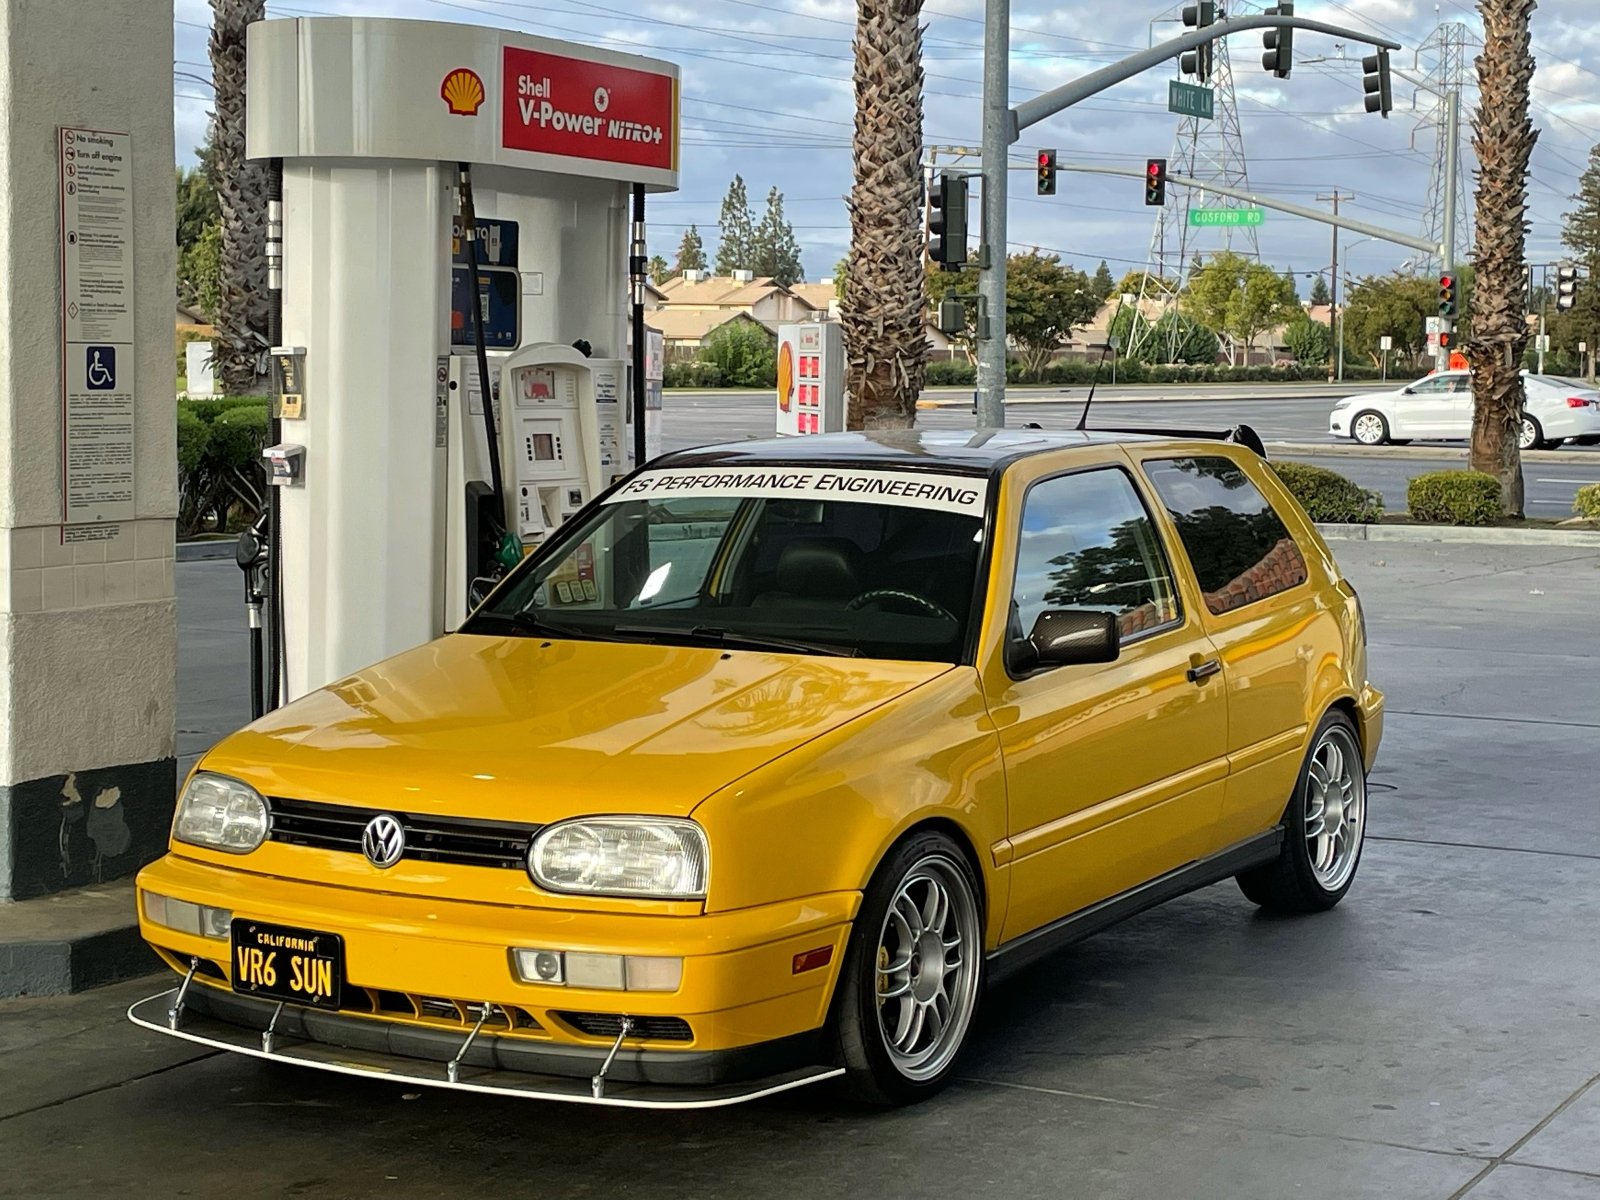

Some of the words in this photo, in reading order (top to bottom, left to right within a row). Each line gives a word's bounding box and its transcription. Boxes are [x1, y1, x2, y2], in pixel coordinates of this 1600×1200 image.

[518, 75, 551, 98] Shell
[1171, 87, 1195, 110] WHITE
[1201, 93, 1212, 113] LN
[518, 98, 602, 136] V-Power
[76, 134, 87, 143] No
[88, 136, 113, 147] smoking
[76, 150, 91, 159] Turn
[91, 151, 101, 160] off
[102, 154, 122, 162] engine
[1194, 211, 1240, 223] GOSFORD
[1247, 212, 1261, 223] RD
[621, 478, 653, 495] FS
[652, 474, 813, 491] PERFORMANCE
[814, 474, 979, 505] ENGINEERING
[257, 933, 315, 952] CALIFORNIA
[237, 946, 277, 987] VR6
[290, 955, 332, 997] SUN
